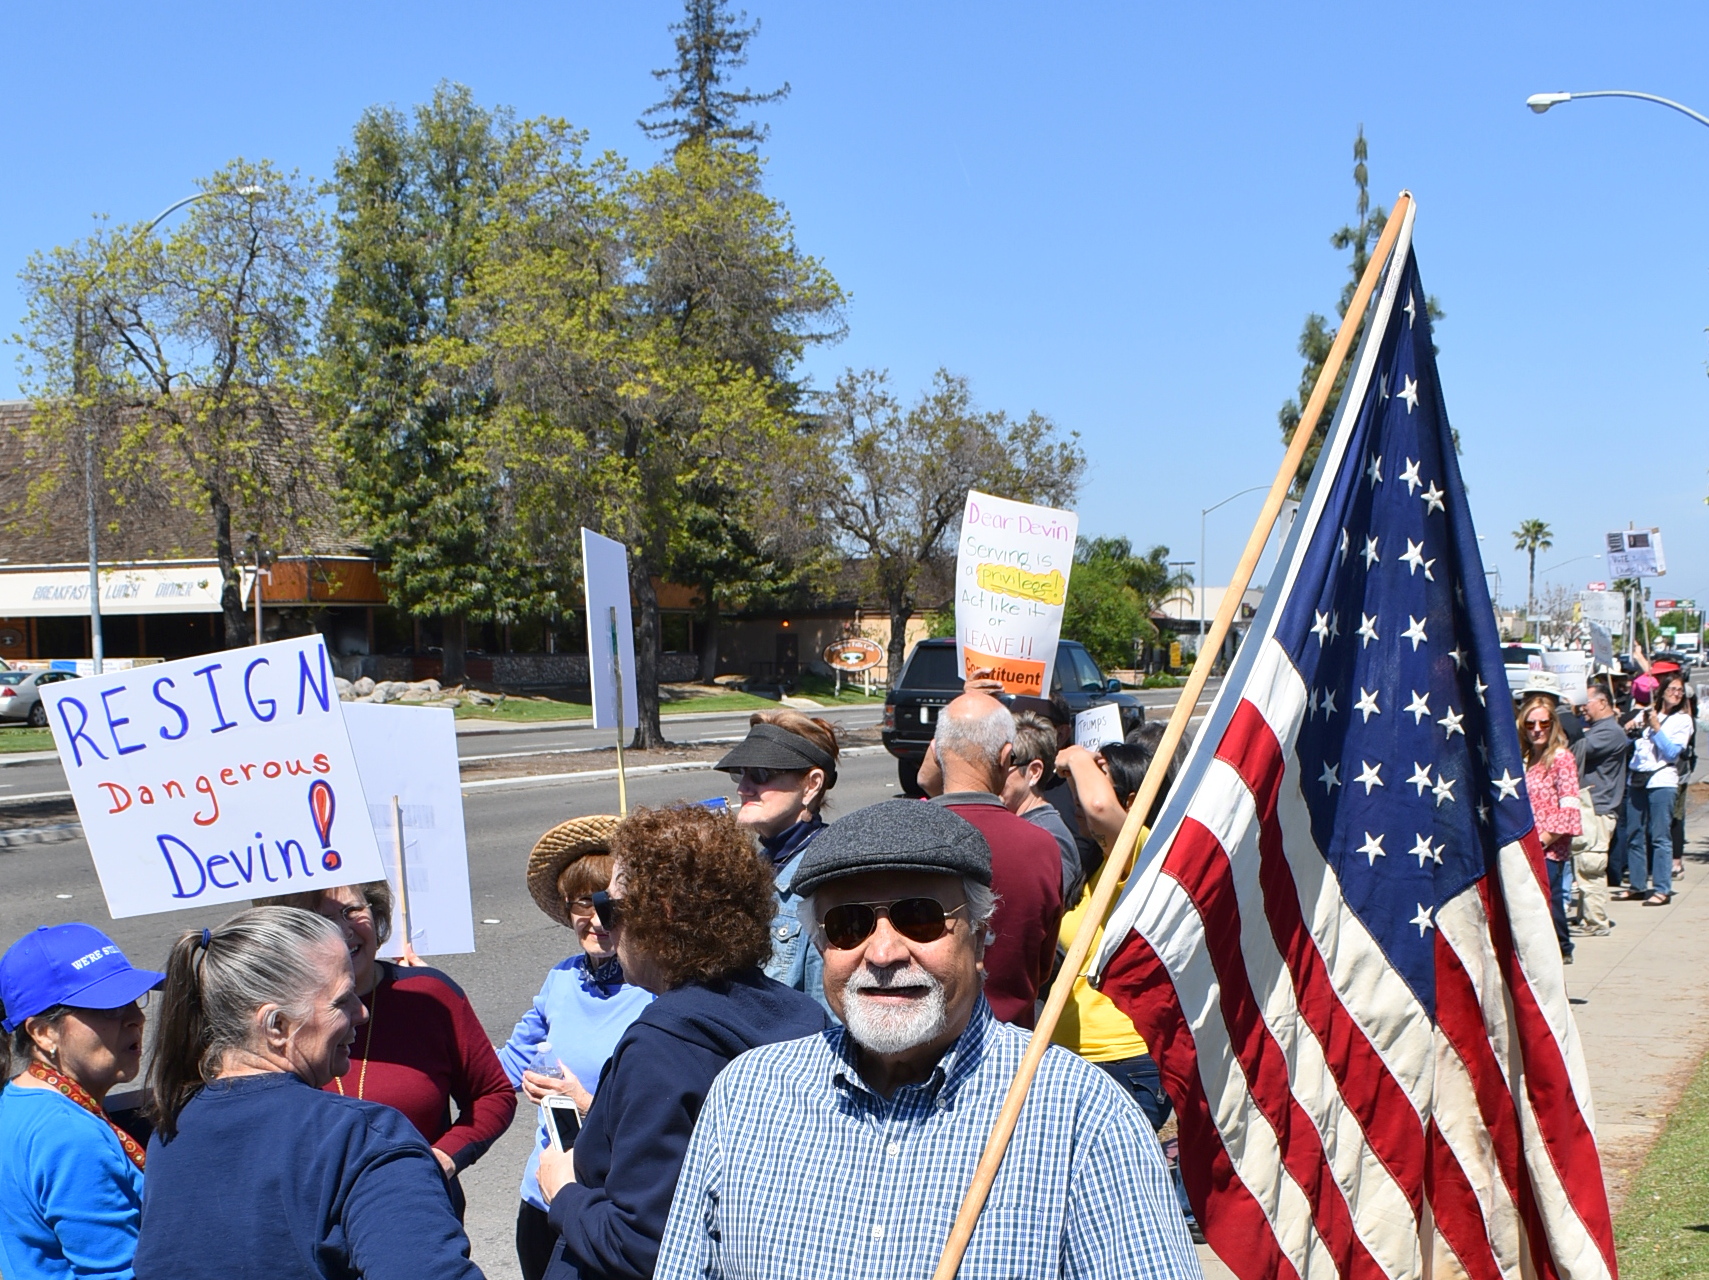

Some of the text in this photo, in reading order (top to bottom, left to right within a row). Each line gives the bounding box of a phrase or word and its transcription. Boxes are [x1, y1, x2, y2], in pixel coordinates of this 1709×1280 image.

[969, 503, 1068, 541] Dear Devin
[966, 536, 1052, 571] Serving is
[33, 582, 194, 601] BREAKFAST LUNCH DINNER
[965, 566, 1058, 598] a privilege!
[962, 589, 1045, 617] Act like it
[988, 618, 1006, 626] or
[57, 643, 329, 767] RESIGN
[98, 754, 331, 826] Dangerous
[156, 779, 342, 898] Devin!
[71, 949, 104, 970] WE'RE
